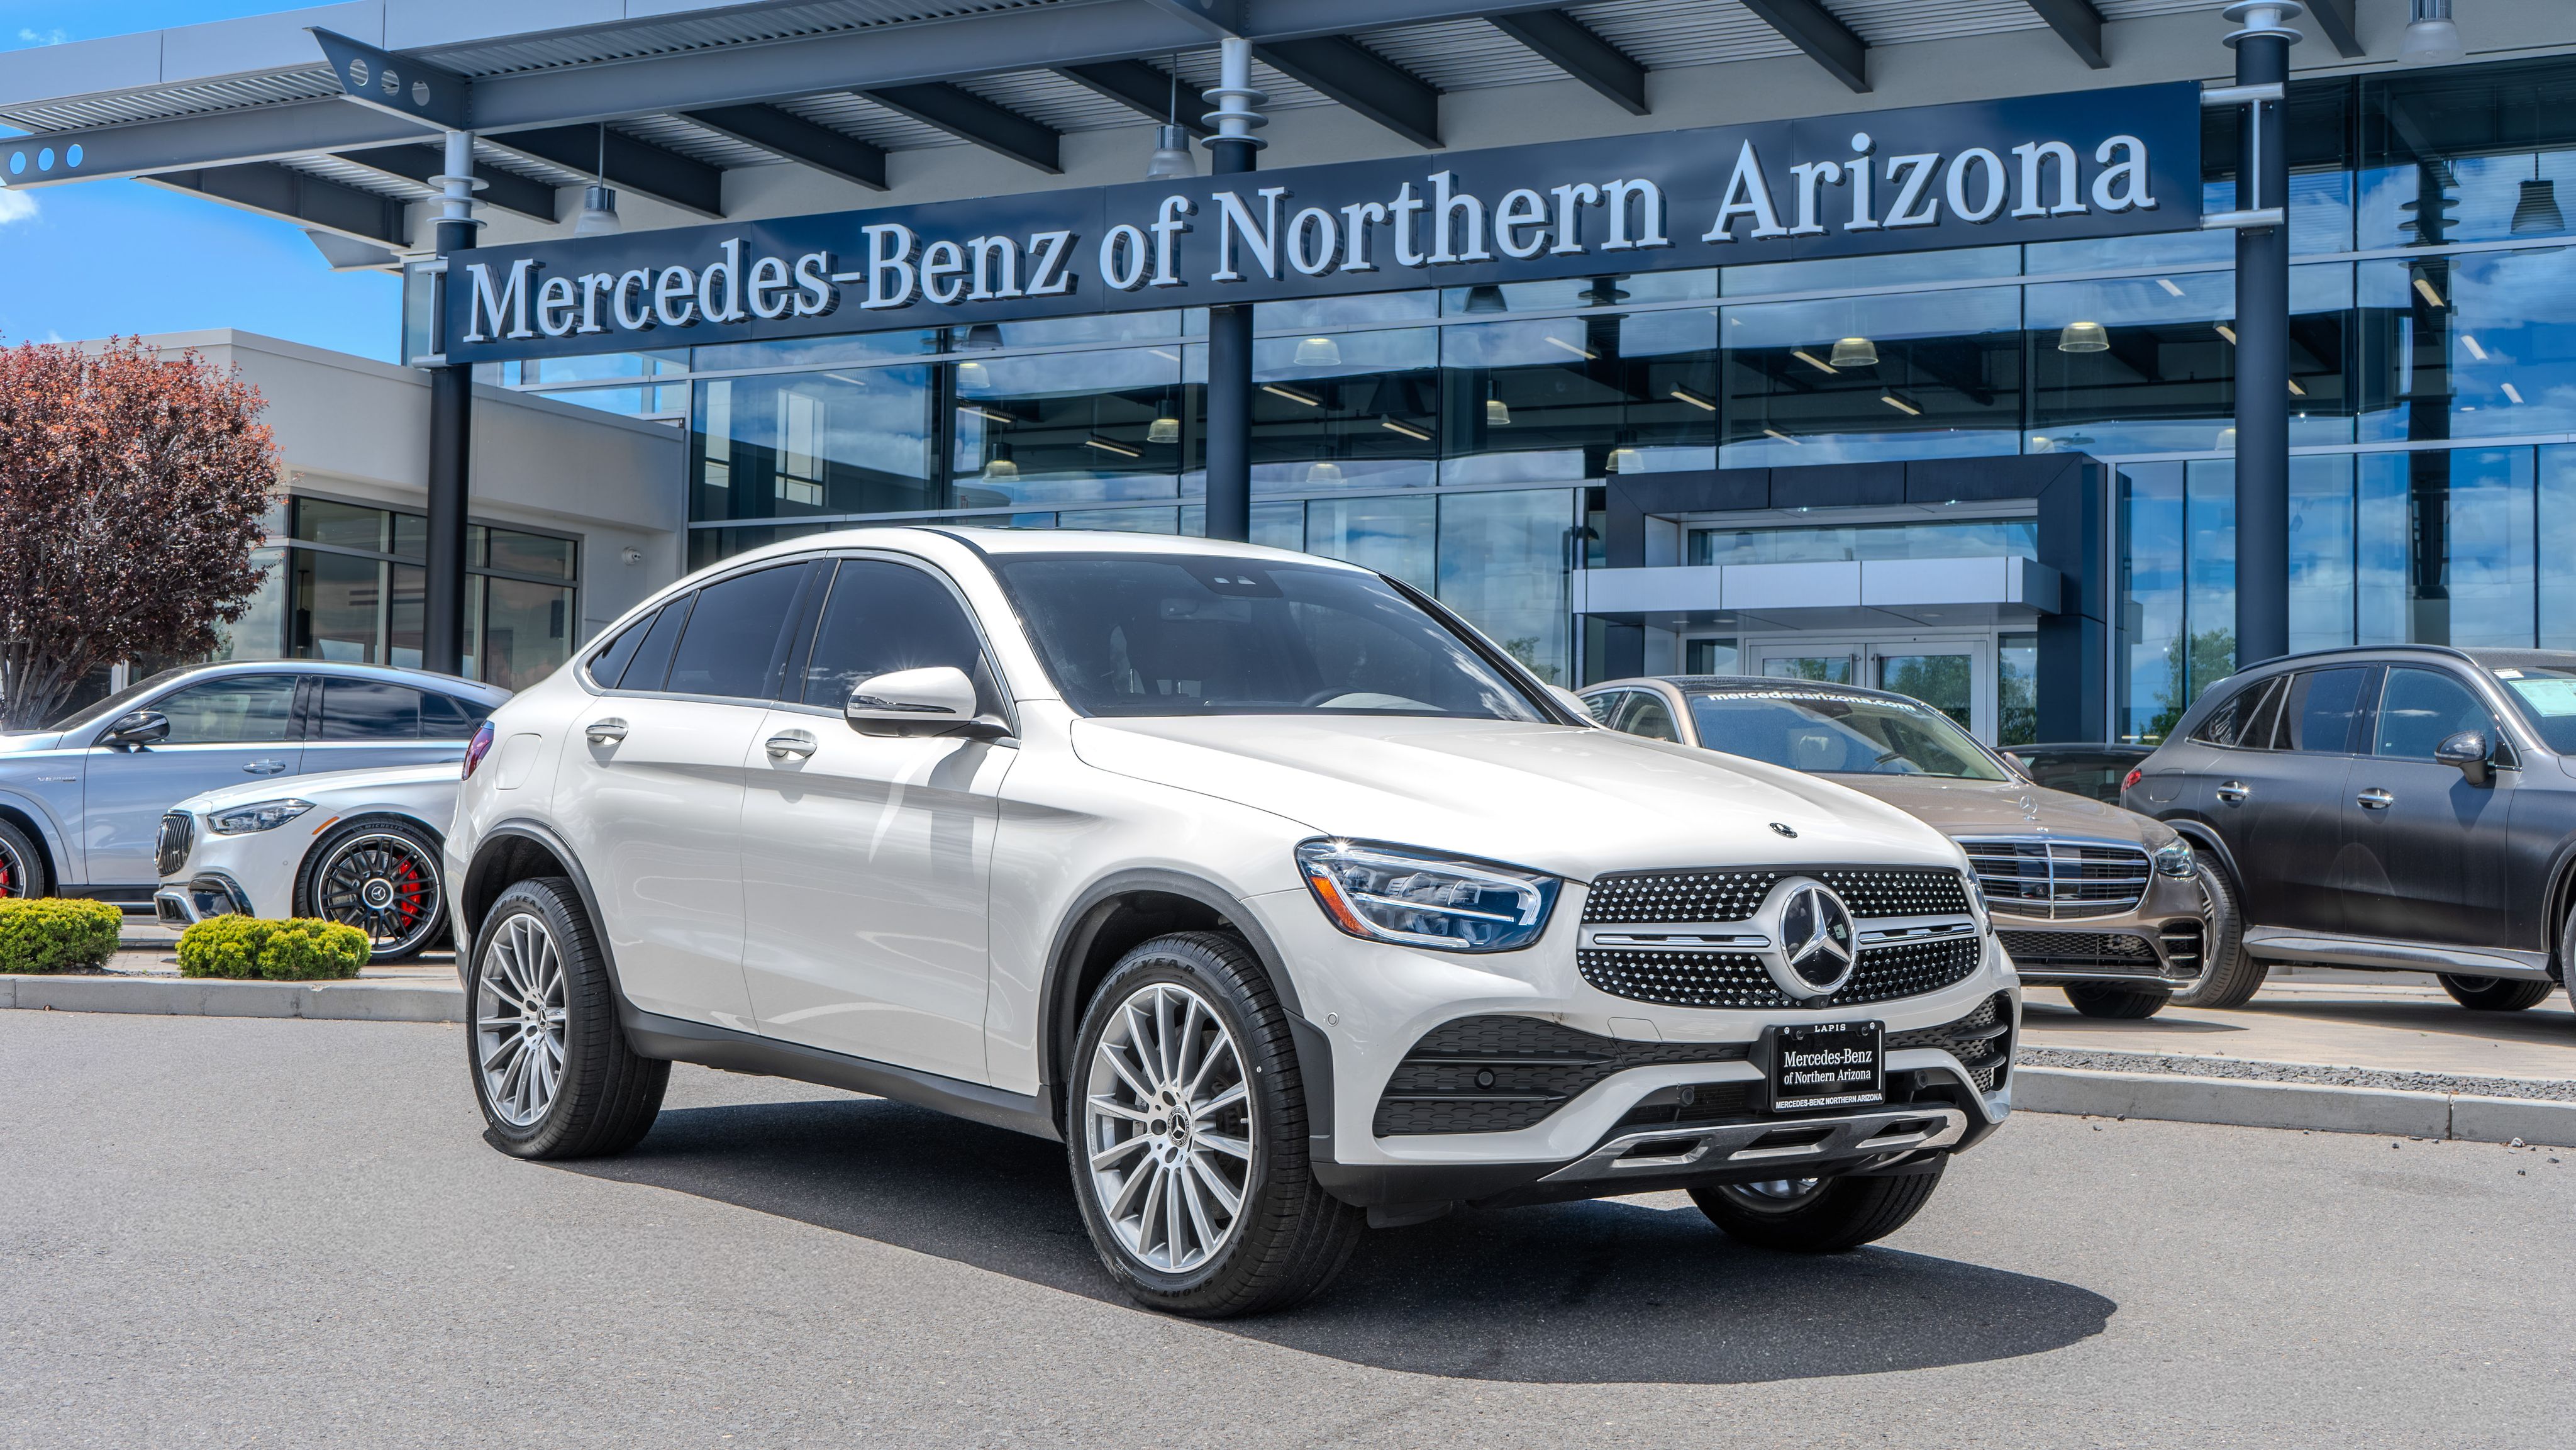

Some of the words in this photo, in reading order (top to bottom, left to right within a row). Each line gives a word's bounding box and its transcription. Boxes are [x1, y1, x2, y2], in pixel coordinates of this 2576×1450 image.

[463, 223, 1078, 343] Mercedes-Benz
[1099, 196, 1195, 292] of
[1211, 170, 1670, 284] Northern
[1702, 133, 2157, 244] Arizona
[1707, 691, 1916, 711] mercedesarizona.com
[1814, 1023, 1846, 1032] LAPIS
[1784, 1048, 1872, 1068] Mercedes-Benz
[1784, 1073, 1794, 1085] of
[1794, 1071, 1835, 1084] Northern
[1837, 1069, 1871, 1081] Arizona
[1775, 1098, 1825, 1109] MERCEDES-BENZ
[1825, 1095, 1857, 1105] NORTHERN
[1857, 1093, 1882, 1103] ARIZONA
